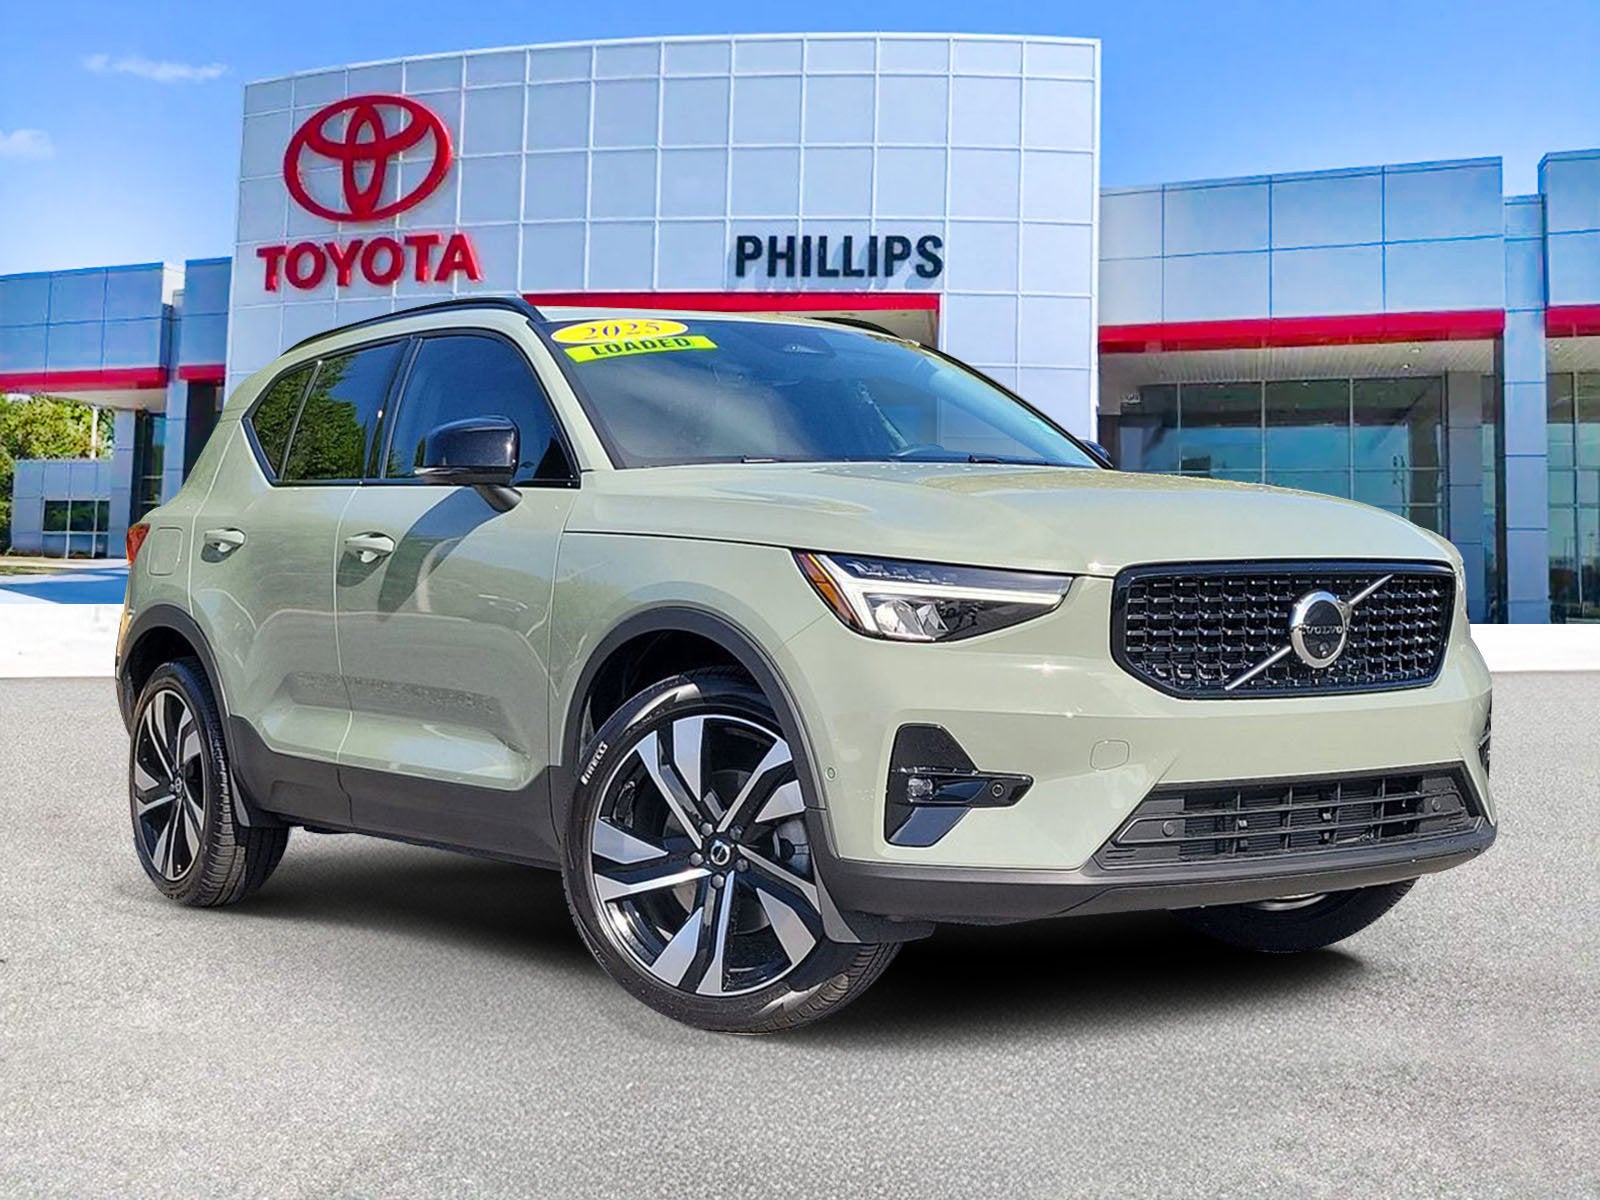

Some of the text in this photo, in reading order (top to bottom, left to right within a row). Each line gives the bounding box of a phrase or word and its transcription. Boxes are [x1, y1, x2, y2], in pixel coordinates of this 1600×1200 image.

[257, 233, 482, 292] TOYOTA
[735, 235, 944, 279] PHILLIPS
[584, 323, 661, 341] 2025
[590, 338, 692, 356] LOADED
[1306, 625, 1343, 635] VOLVO
